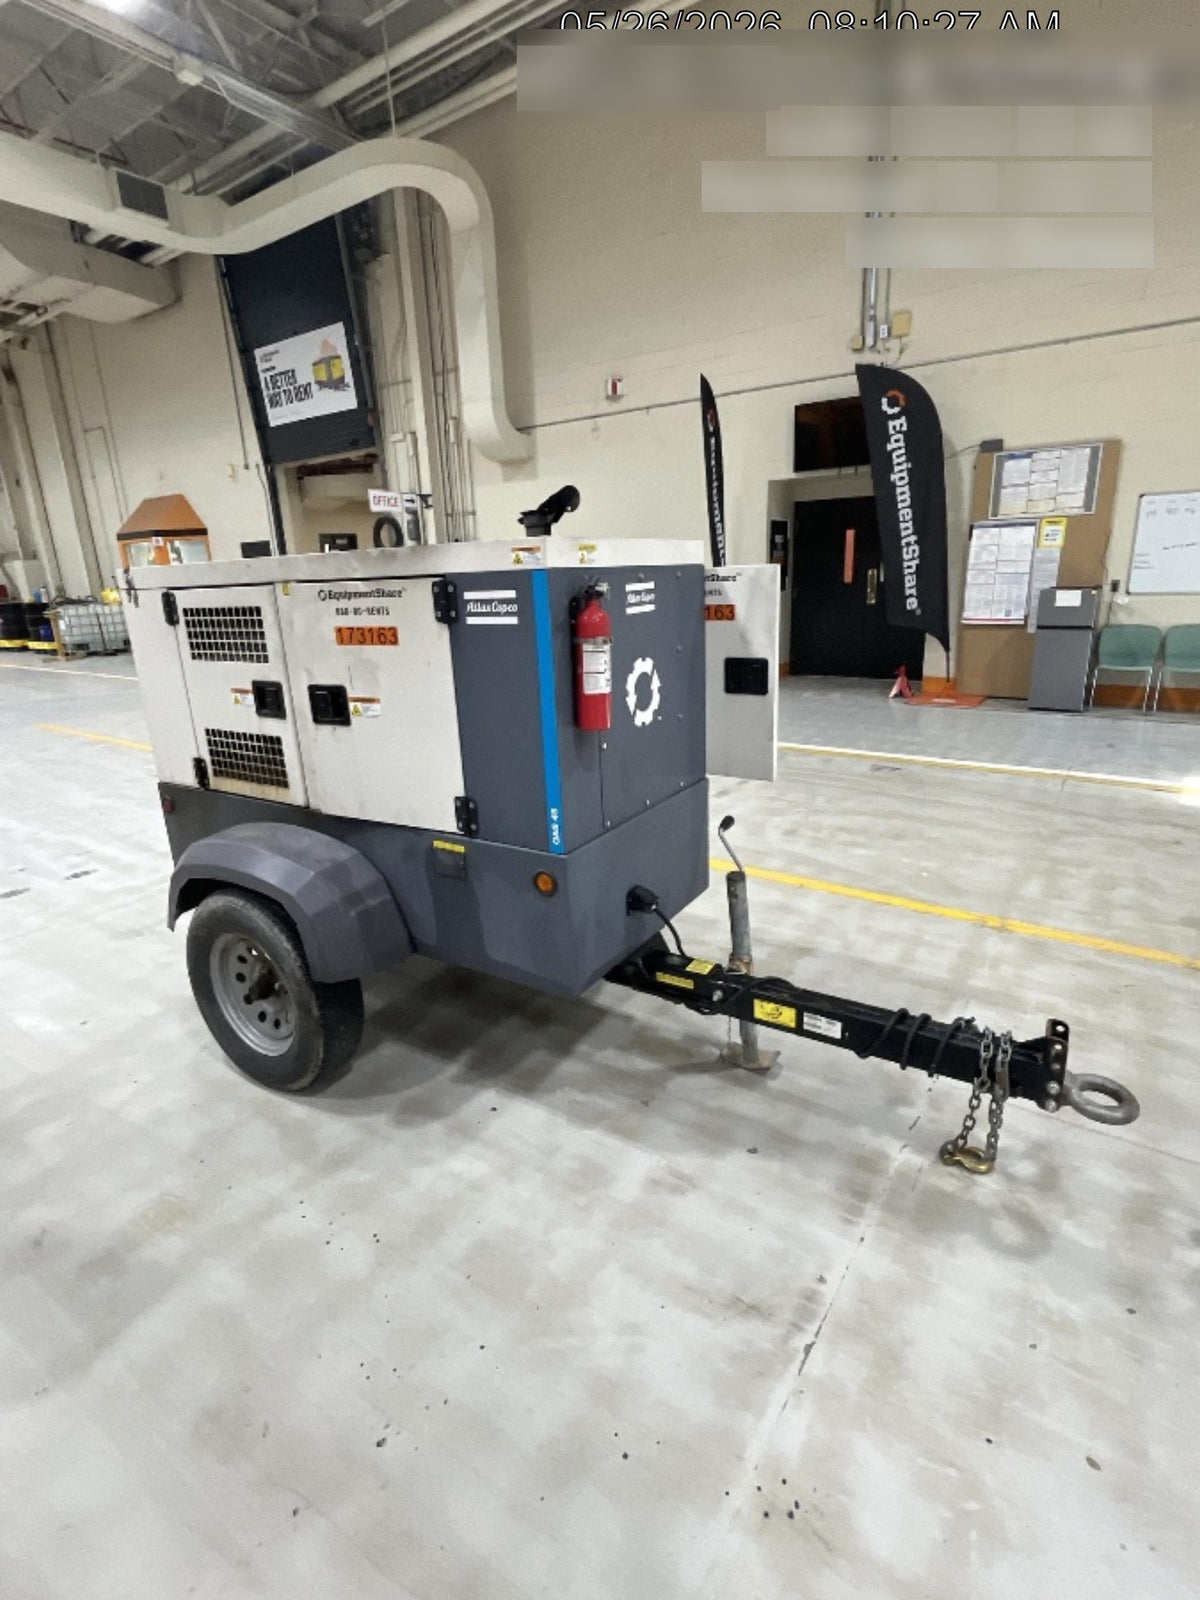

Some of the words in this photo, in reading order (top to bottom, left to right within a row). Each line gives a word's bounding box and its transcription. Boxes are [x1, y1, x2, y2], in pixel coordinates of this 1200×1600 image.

[372, 495, 399, 507] OFFICE
[887, 416, 920, 610] EquipmentShare
[466, 601, 491, 613] Atlas
[491, 600, 519, 615] Copco
[336, 627, 399, 645] 173163
